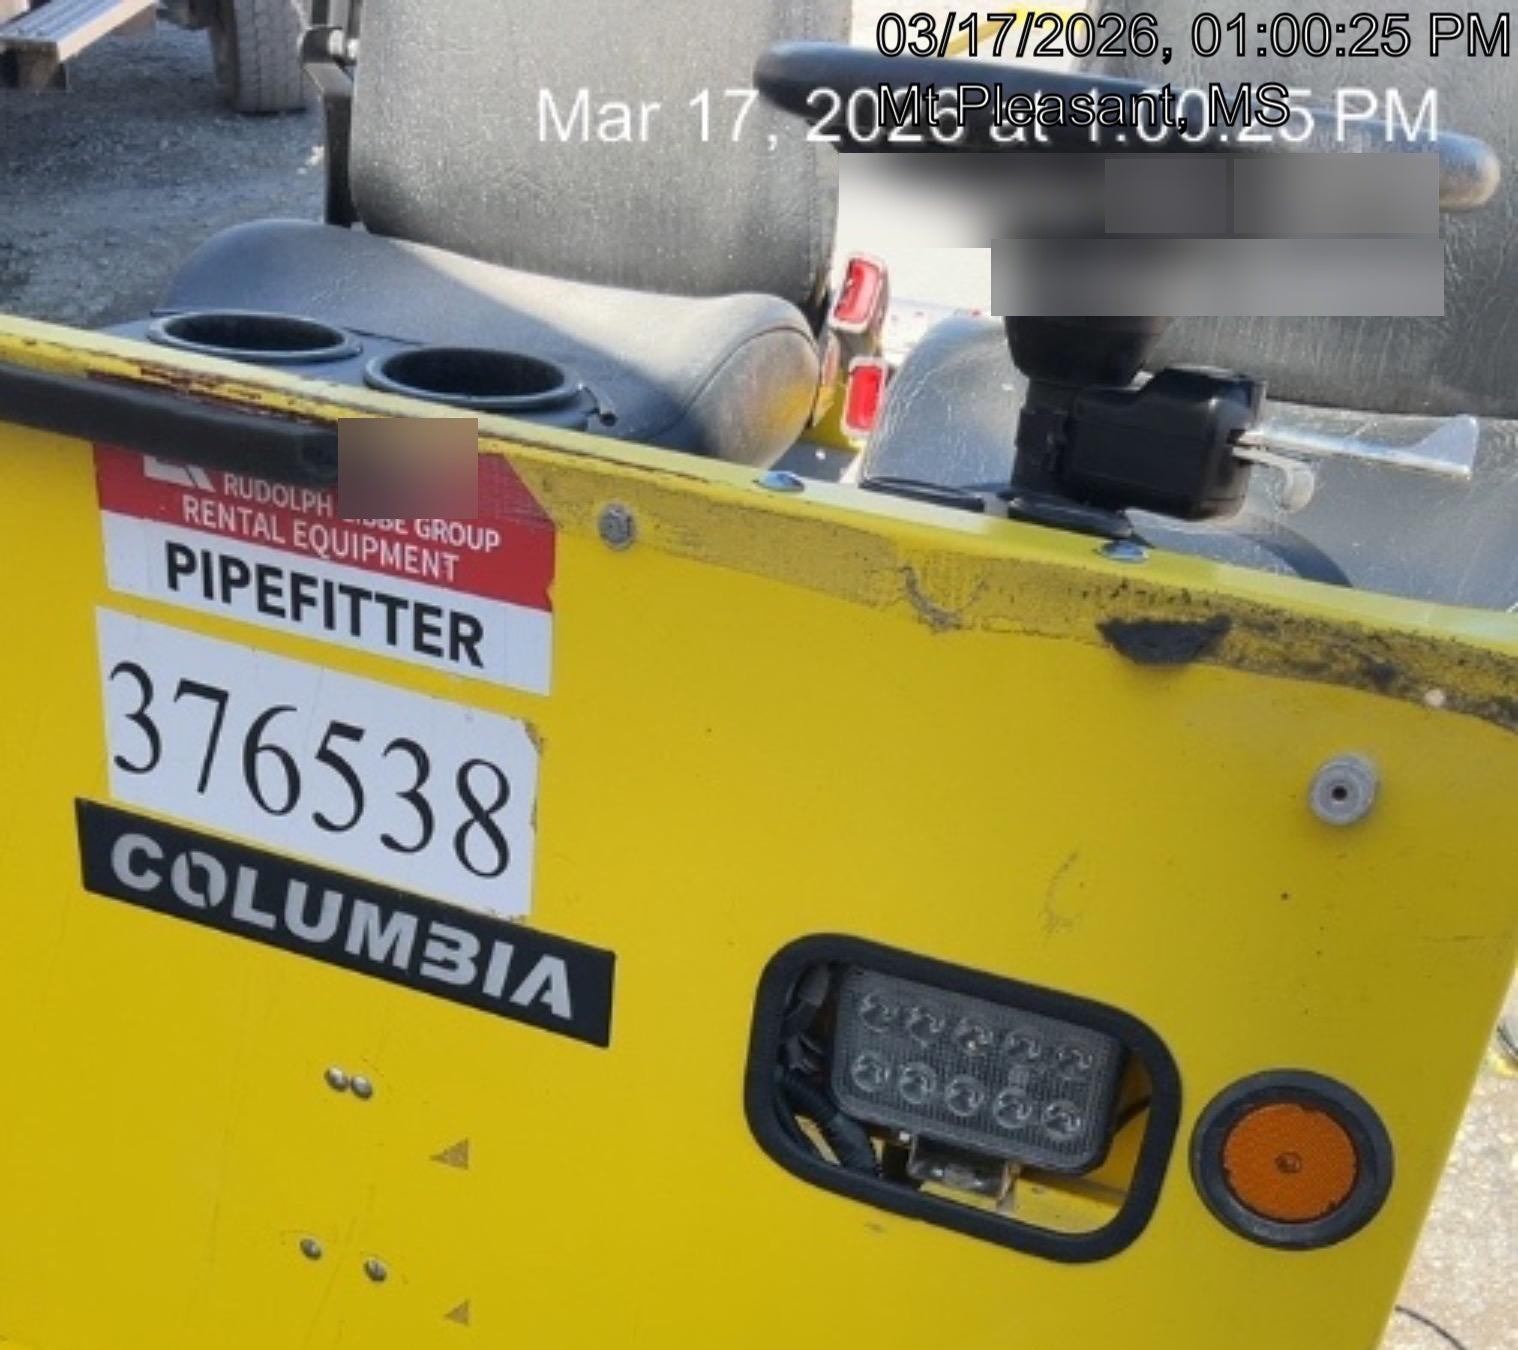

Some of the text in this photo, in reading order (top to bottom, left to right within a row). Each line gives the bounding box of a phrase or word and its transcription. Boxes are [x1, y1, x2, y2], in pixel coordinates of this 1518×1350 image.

[182, 494, 460, 582] RENTAL EQUIPMENT
[223, 473, 333, 518] RUDOLPH
[413, 518, 502, 552] GROUP
[164, 541, 486, 669] PIPEFITTER
[108, 661, 512, 879] 376538
[110, 832, 573, 1020] COLUMBIA
